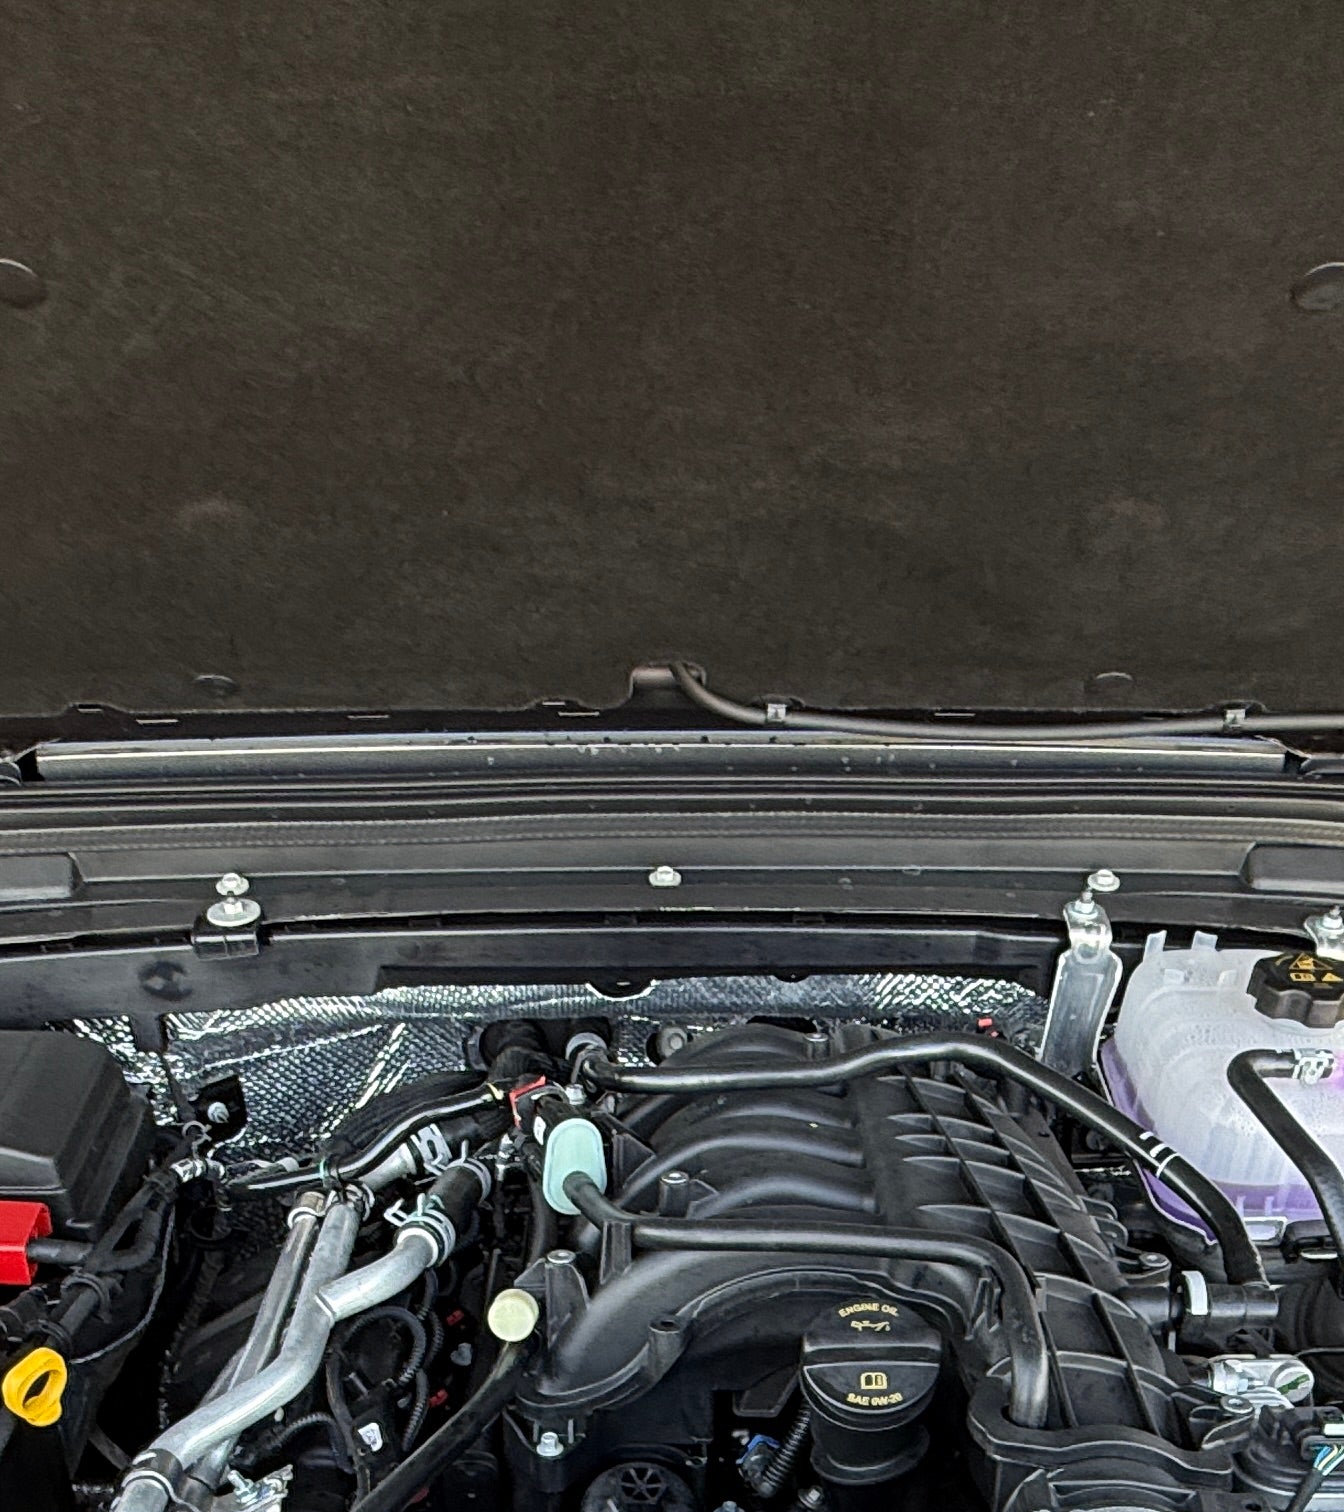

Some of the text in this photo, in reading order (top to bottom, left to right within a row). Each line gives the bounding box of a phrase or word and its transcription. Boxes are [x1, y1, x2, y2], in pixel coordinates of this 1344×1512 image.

[838, 1303, 899, 1318] ENGINE OIL
[846, 1392, 870, 1406] SAE
